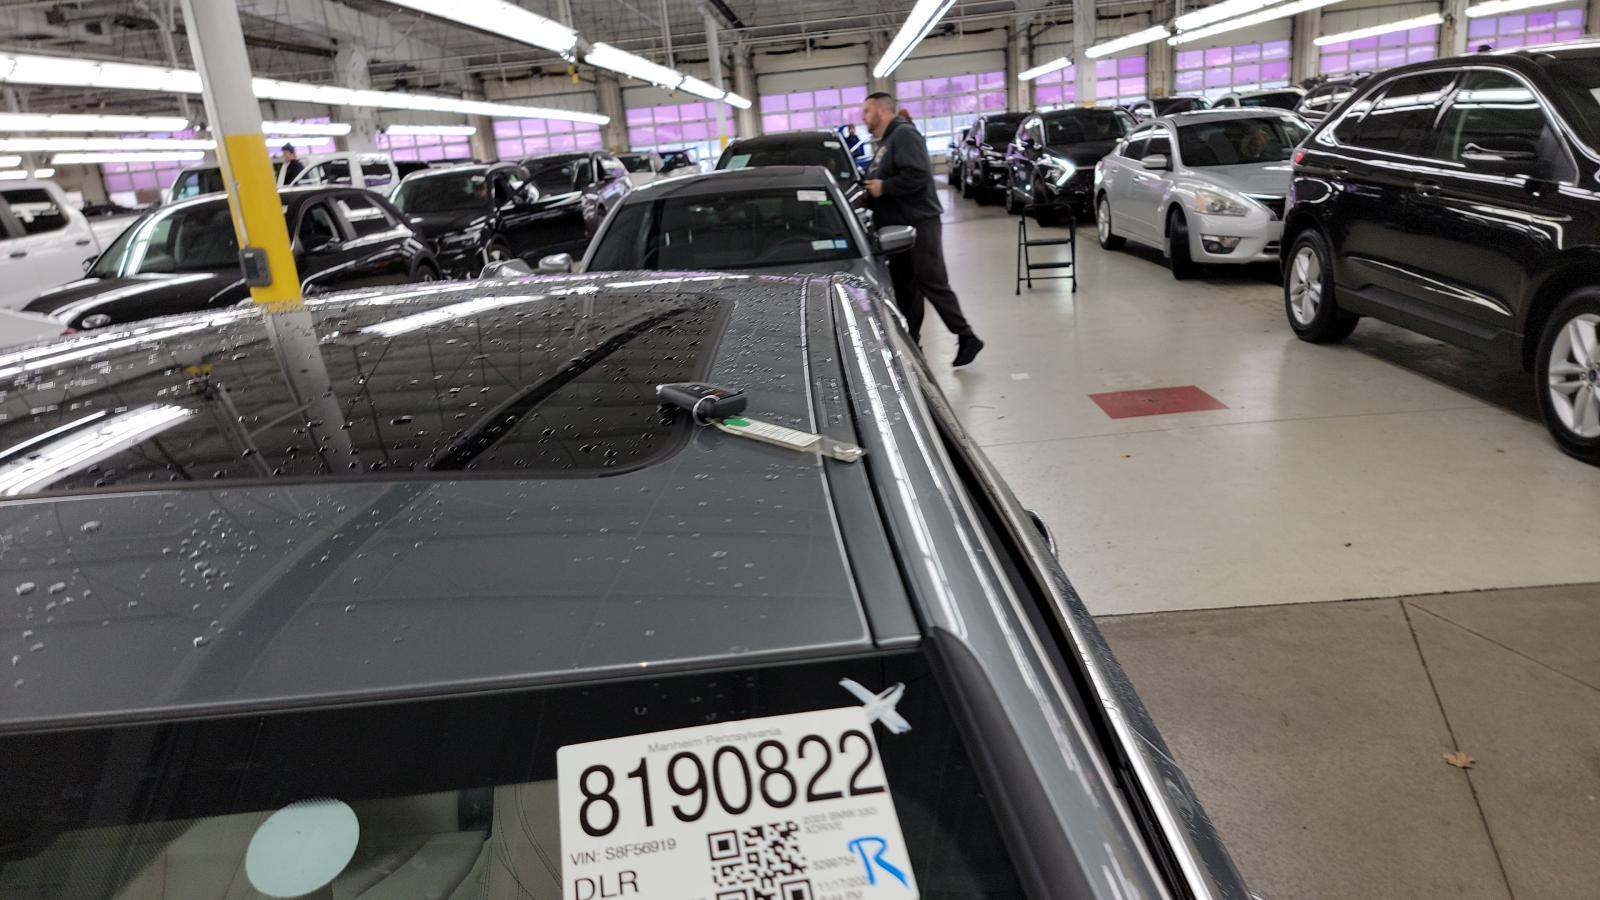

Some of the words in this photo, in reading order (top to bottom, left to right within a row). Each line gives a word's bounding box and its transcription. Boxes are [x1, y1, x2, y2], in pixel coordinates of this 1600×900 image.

[648, 738, 702, 752] Manheim
[706, 728, 782, 744] Pennsylvania
[579, 730, 886, 837] 8190822
[571, 850, 600, 866] VIN:
[604, 838, 677, 860] S8F56919
[848, 836, 910, 888] R
[574, 870, 639, 900] DLR
